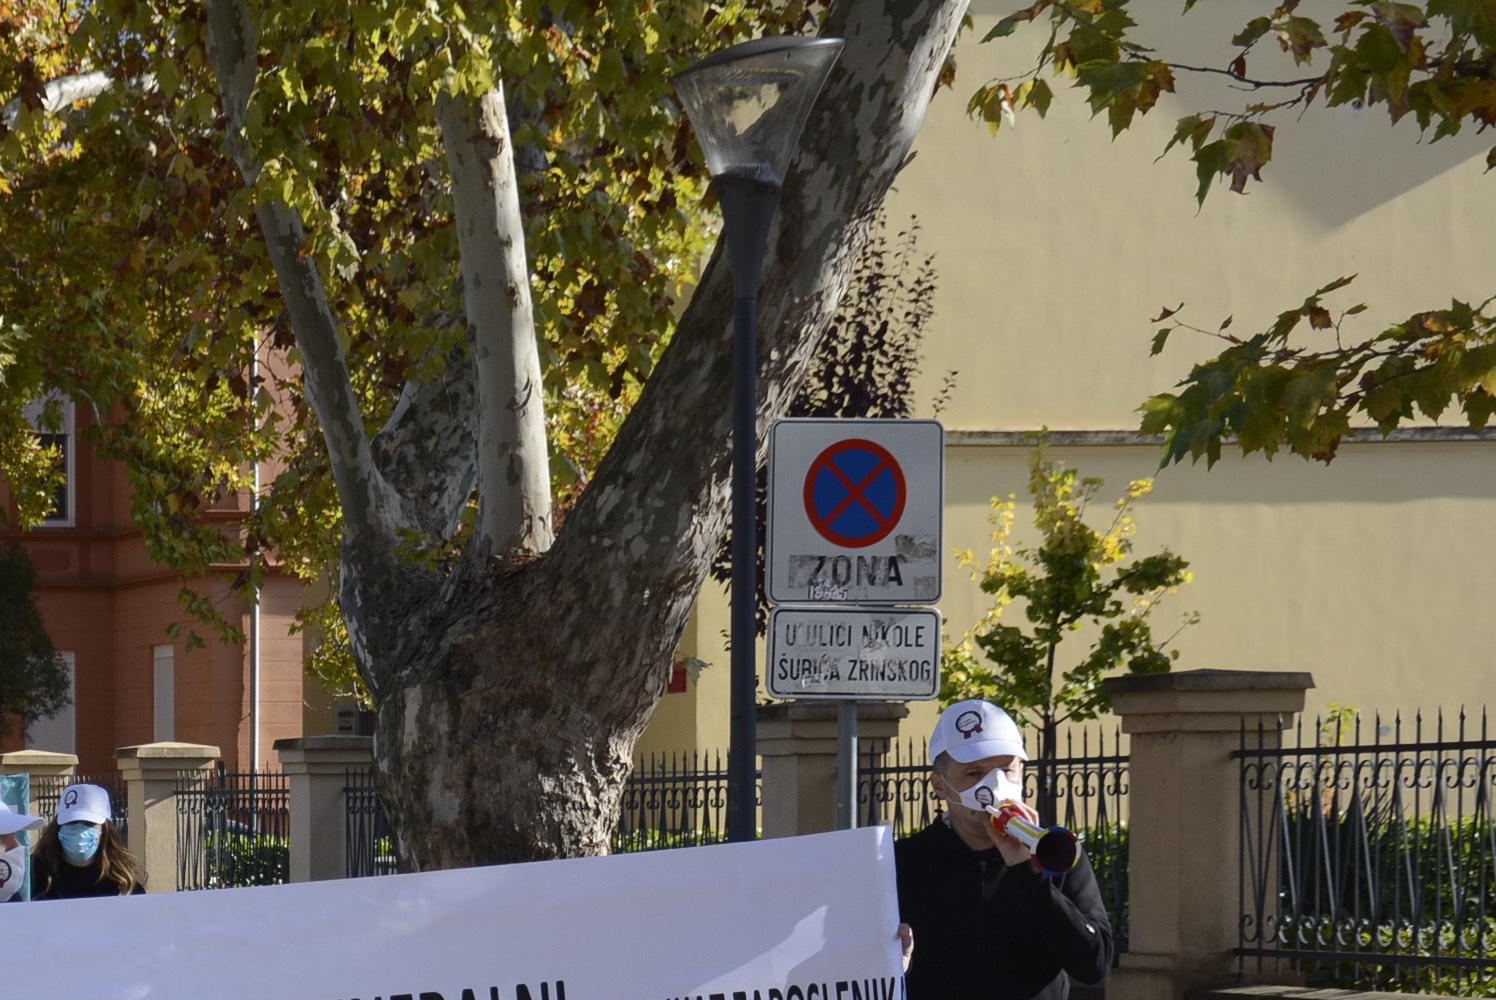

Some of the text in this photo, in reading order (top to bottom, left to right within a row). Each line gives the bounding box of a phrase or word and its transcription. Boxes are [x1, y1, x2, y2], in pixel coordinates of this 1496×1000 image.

[807, 555, 903, 586] ZONA
[785, 624, 925, 648] U ULICI NIKOLE
[847, 659, 931, 681] ZRINSKOG
